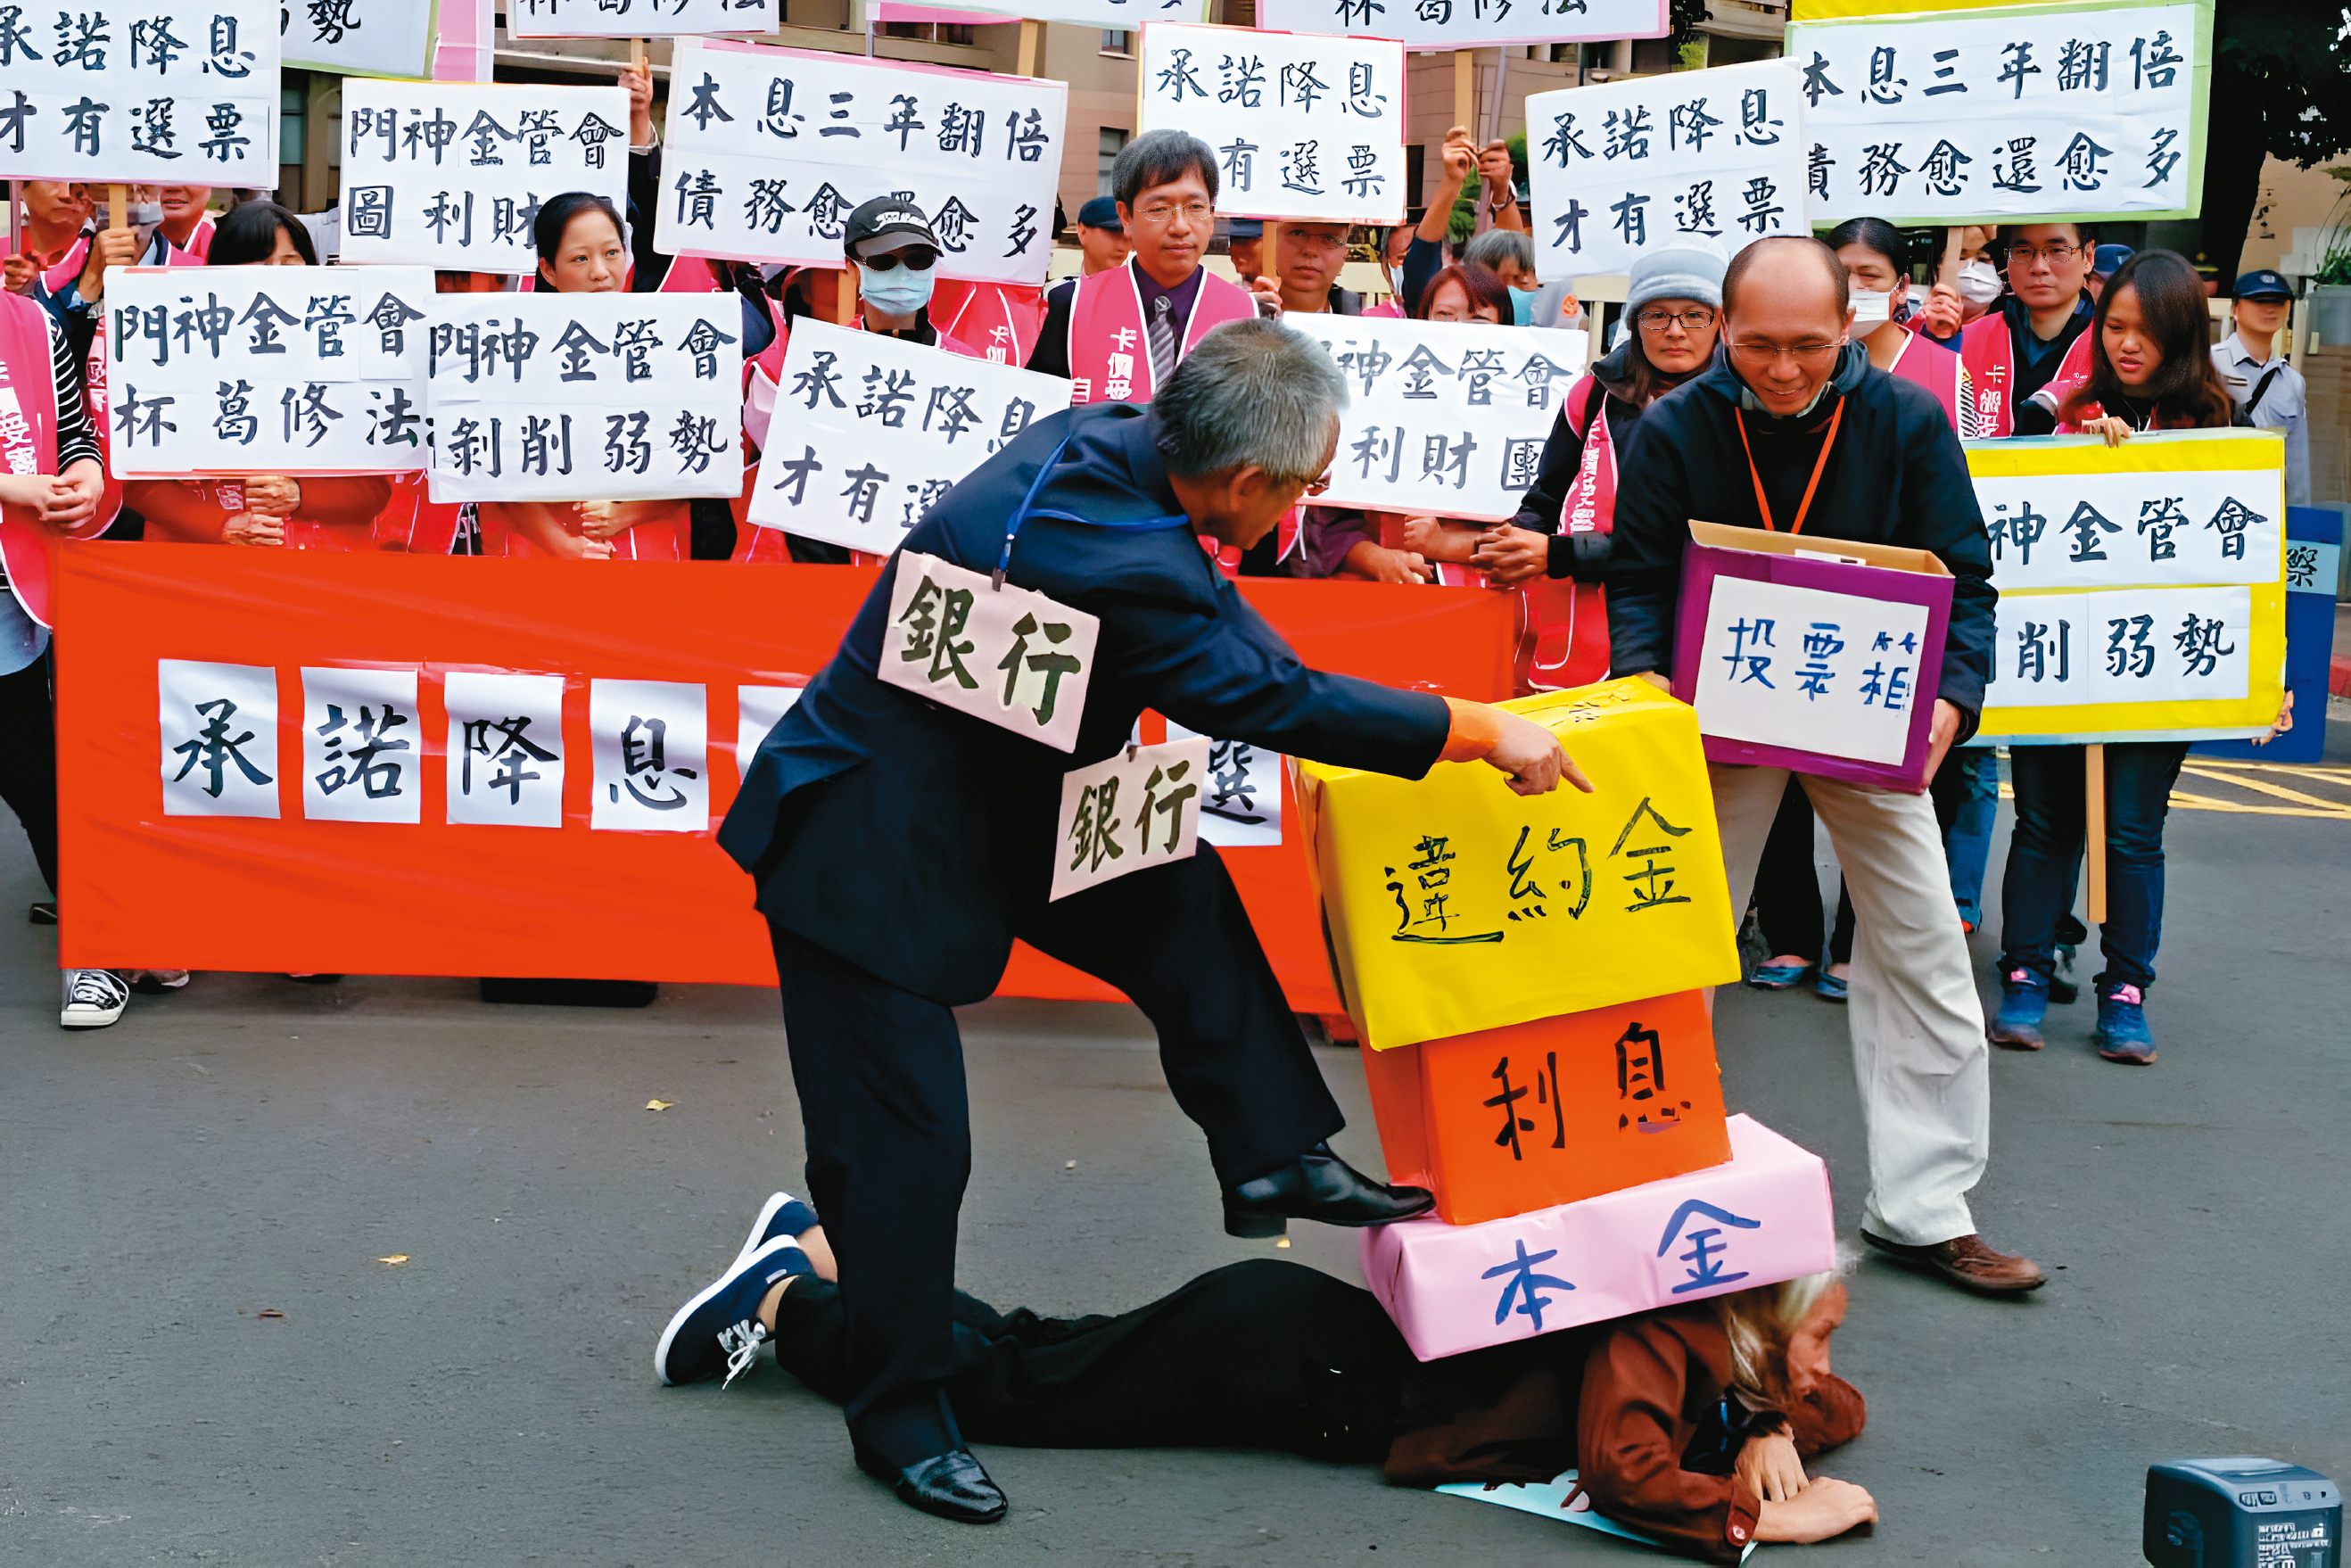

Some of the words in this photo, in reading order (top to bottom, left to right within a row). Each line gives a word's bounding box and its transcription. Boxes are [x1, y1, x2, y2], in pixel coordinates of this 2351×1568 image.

[0, 6, 256, 78] 承諾降息
[281, 0, 361, 45] 勢
[1157, 47, 1388, 118] 承諾降息
[1802, 30, 2184, 108] 本息三年翻倍
[0, 90, 252, 161] 才有選票
[351, 106, 624, 169] 門神金管會
[681, 72, 1050, 162] 本息三年翻倍
[1542, 89, 1784, 169] 承諾降息
[349, 185, 613, 249] 圖利財
[674, 169, 1038, 259] 債務愈愈多
[1552, 177, 1784, 254] 才有選票
[115, 292, 426, 367] 門神金管會
[429, 317, 737, 384] 門神金管會
[113, 378, 421, 448] 杯葛修法
[1320, 339, 1572, 410] 神金管會
[897, 575, 1081, 726] 銀行
[1722, 617, 1918, 711] 投票箱
[1987, 613, 2234, 684] 削弱勢
[173, 698, 697, 810] 承諾降息
[1068, 760, 1197, 873] 銀行
[1385, 797, 1692, 944] 違約金
[1483, 1021, 1690, 1160] 利息
[1481, 1199, 1761, 1331] 本金
